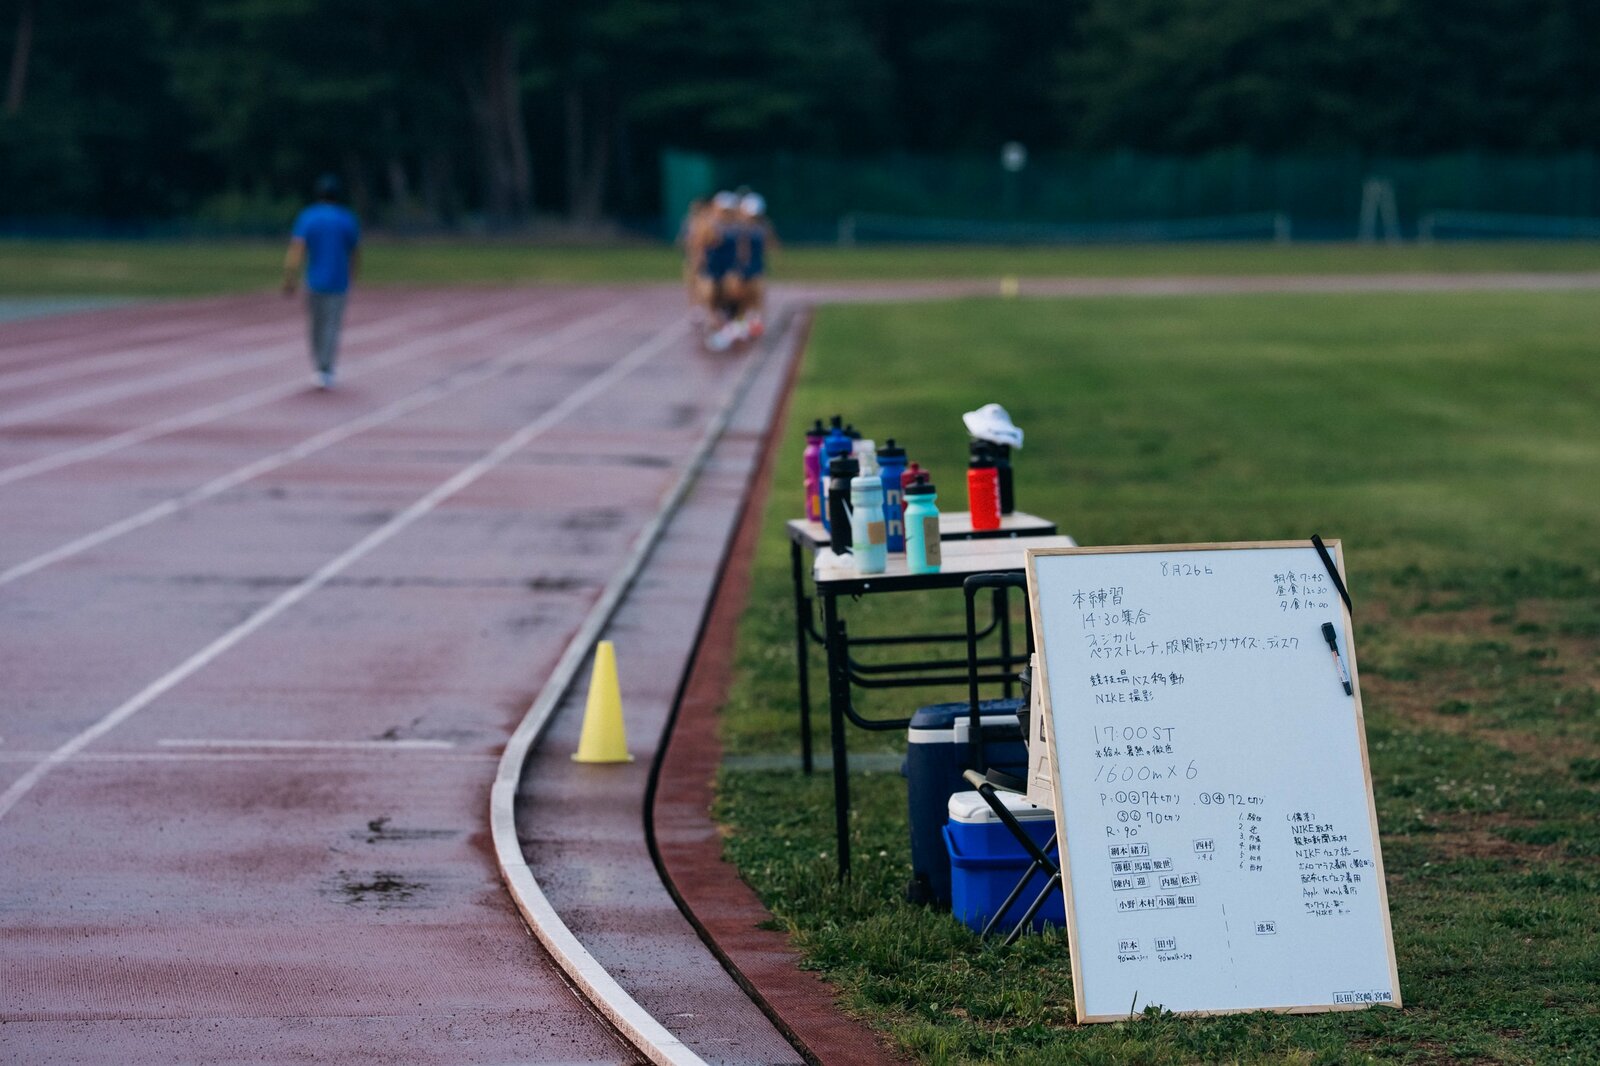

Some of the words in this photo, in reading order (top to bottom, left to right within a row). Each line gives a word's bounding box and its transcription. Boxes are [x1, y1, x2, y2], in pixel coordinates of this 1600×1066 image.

[1160, 561, 1213, 577] 8月26日
[1273, 571, 1297, 583] 朝食
[1299, 573, 1325, 583] 7:45
[1302, 585, 1328, 596] 12:30
[1072, 586, 1124, 610] 本練習
[1279, 597, 1301, 611] 夕食
[1082, 608, 1151, 629] 14:30集合
[1134, 860, 1152, 872] 馬場
[1181, 874, 1198, 886] 松井
[1138, 897, 1156, 909] 木村
